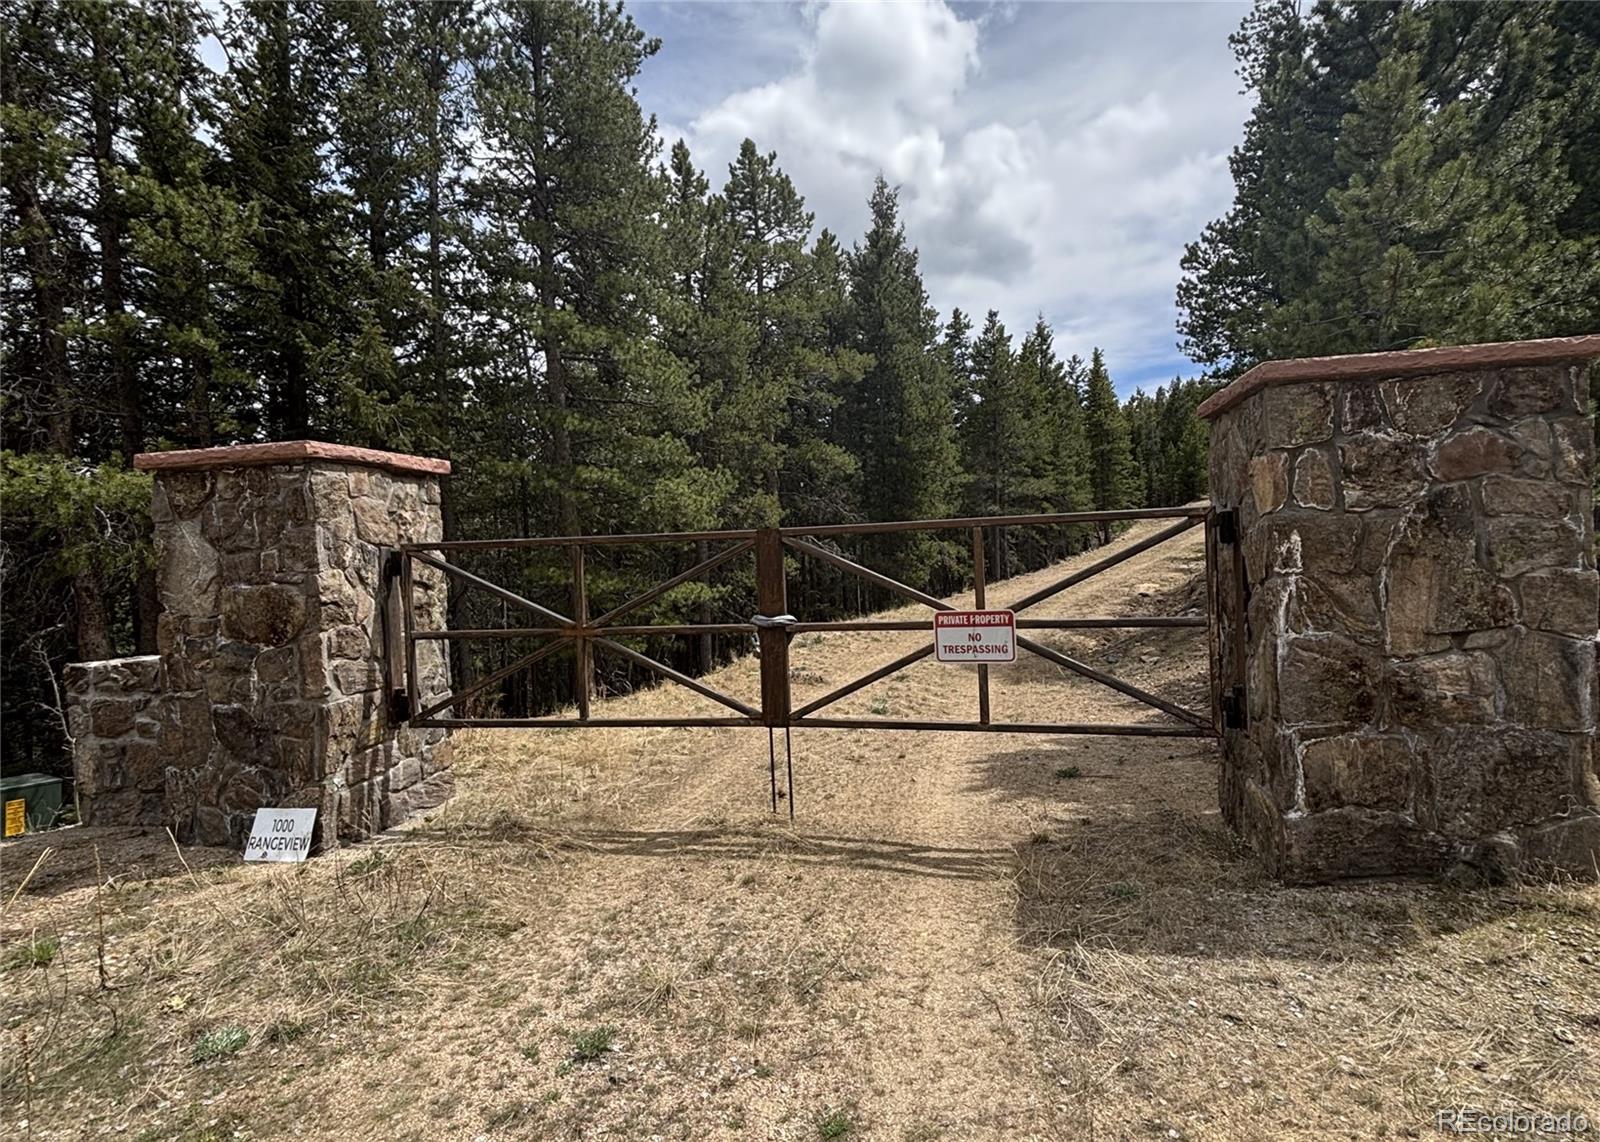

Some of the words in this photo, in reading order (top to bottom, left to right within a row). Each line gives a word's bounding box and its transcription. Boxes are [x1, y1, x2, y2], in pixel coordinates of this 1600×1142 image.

[938, 615, 968, 625] PRIVATE
[970, 614, 1010, 624] PROPERTY
[968, 632, 982, 642] NO
[943, 644, 1009, 654] TRESPASSING
[272, 818, 295, 833] 1000
[248, 836, 310, 851] RANGEVIEW
